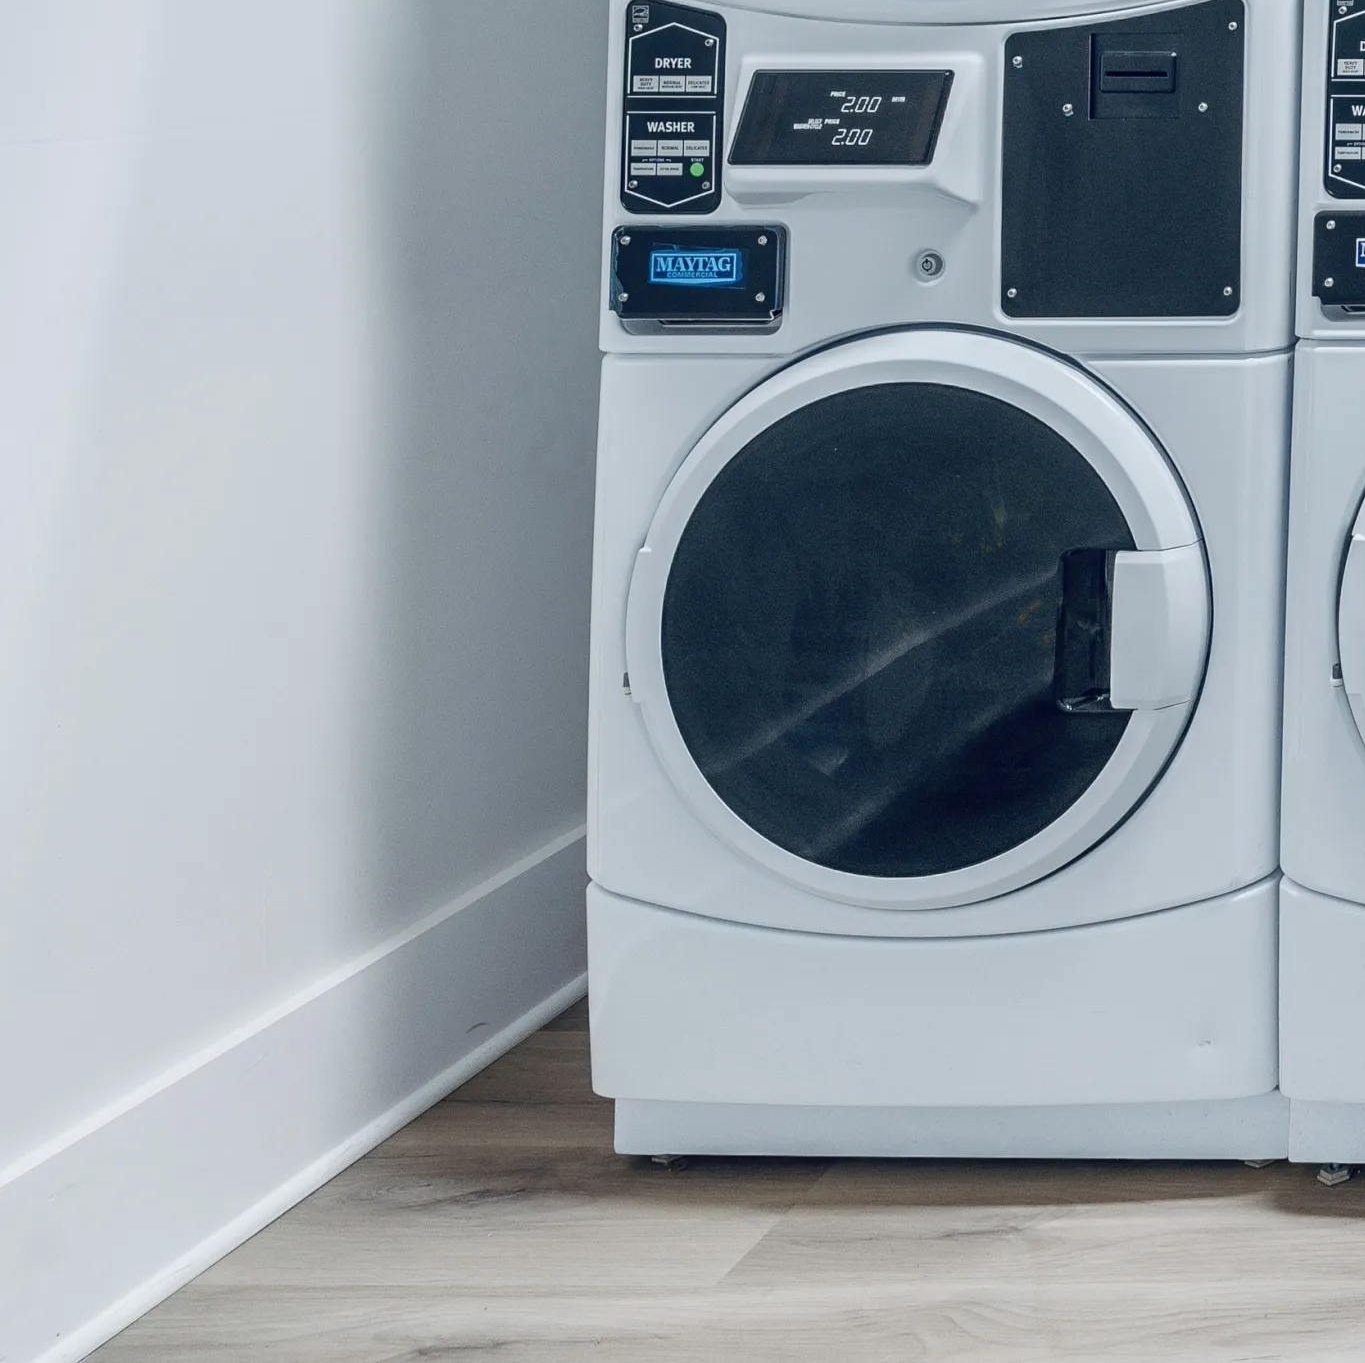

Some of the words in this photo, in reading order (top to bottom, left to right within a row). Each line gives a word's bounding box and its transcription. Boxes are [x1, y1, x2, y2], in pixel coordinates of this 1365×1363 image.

[654, 57, 691, 69] DRYER
[840, 96, 882, 113] 2.00
[646, 121, 695, 133] WASHER
[831, 128, 873, 145] 2.00
[655, 257, 732, 272] MAYTAG
